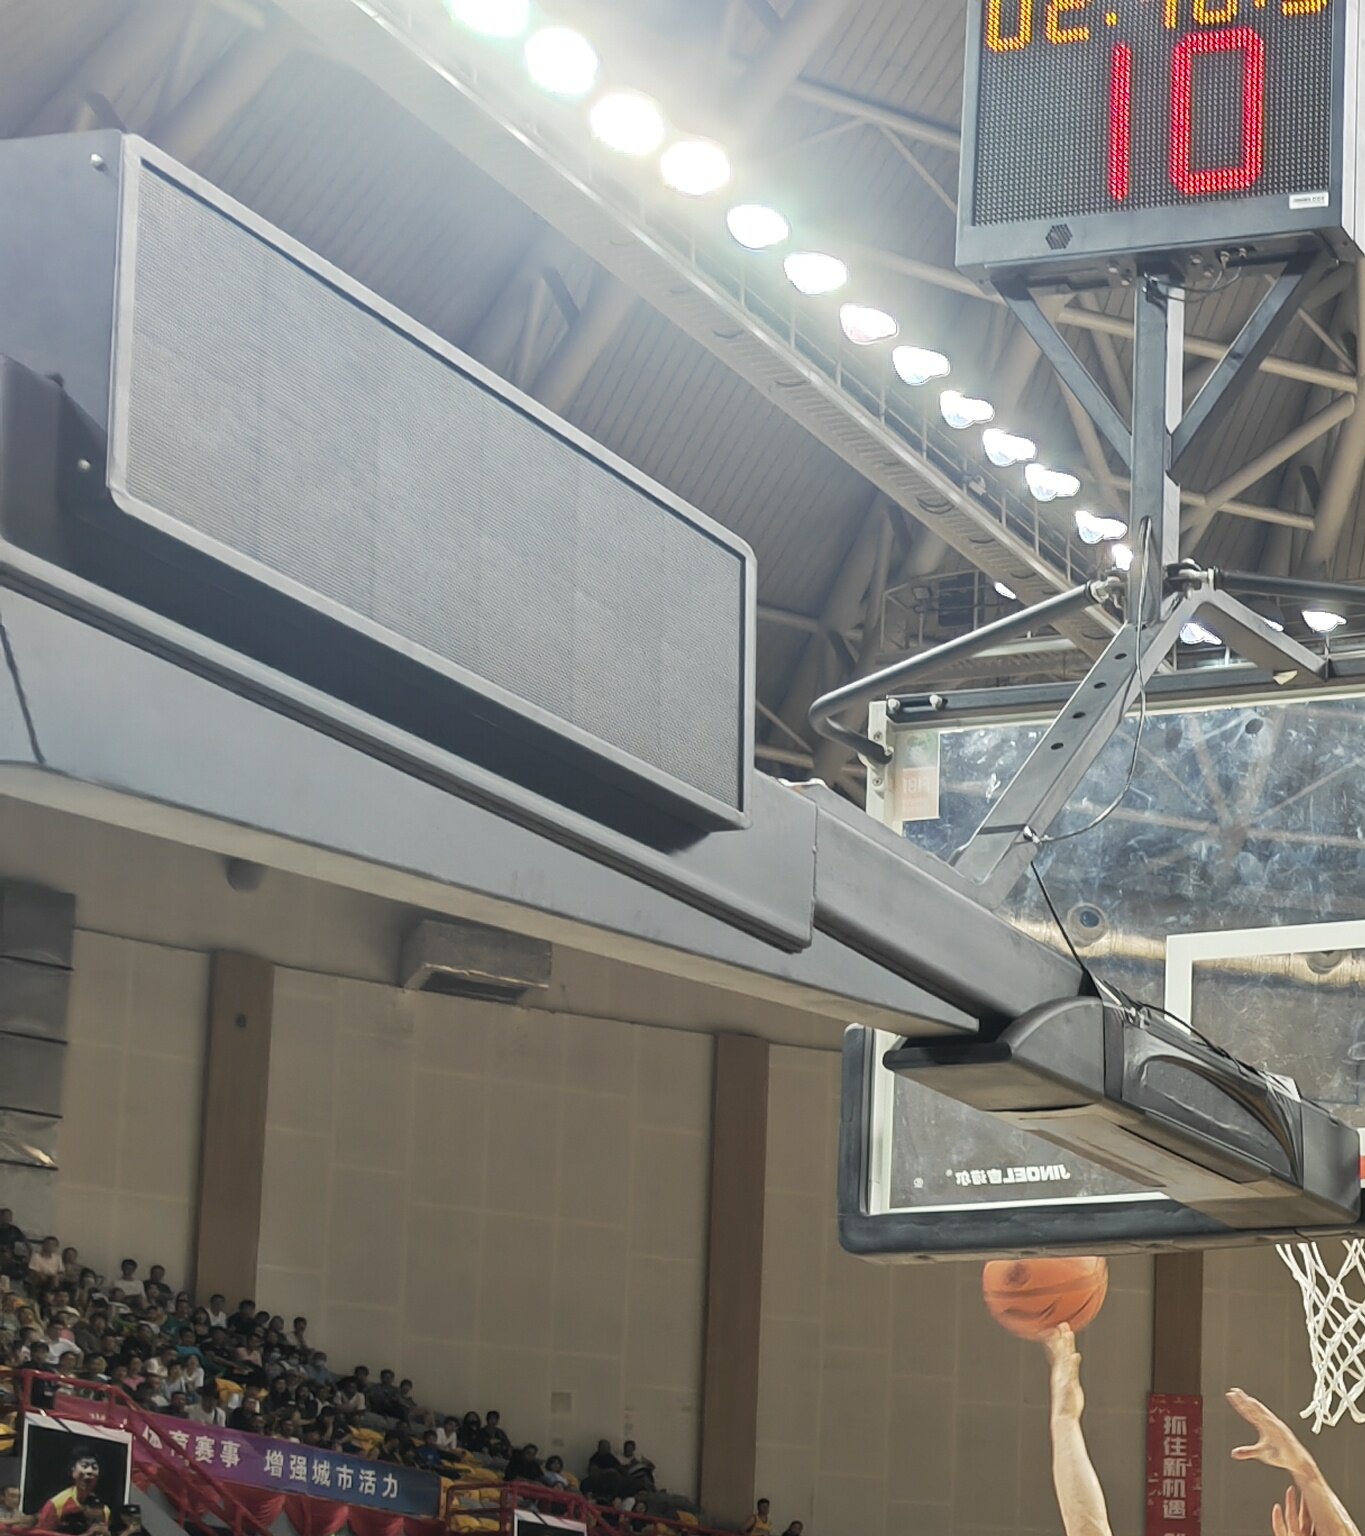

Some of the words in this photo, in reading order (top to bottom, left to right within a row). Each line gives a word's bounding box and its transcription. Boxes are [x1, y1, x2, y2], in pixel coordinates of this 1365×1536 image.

[1107, 26, 1266, 201] 10
[264, 1449, 400, 1500] 增强城市活力
[1162, 1415, 1187, 1520] 抓住新机遇
